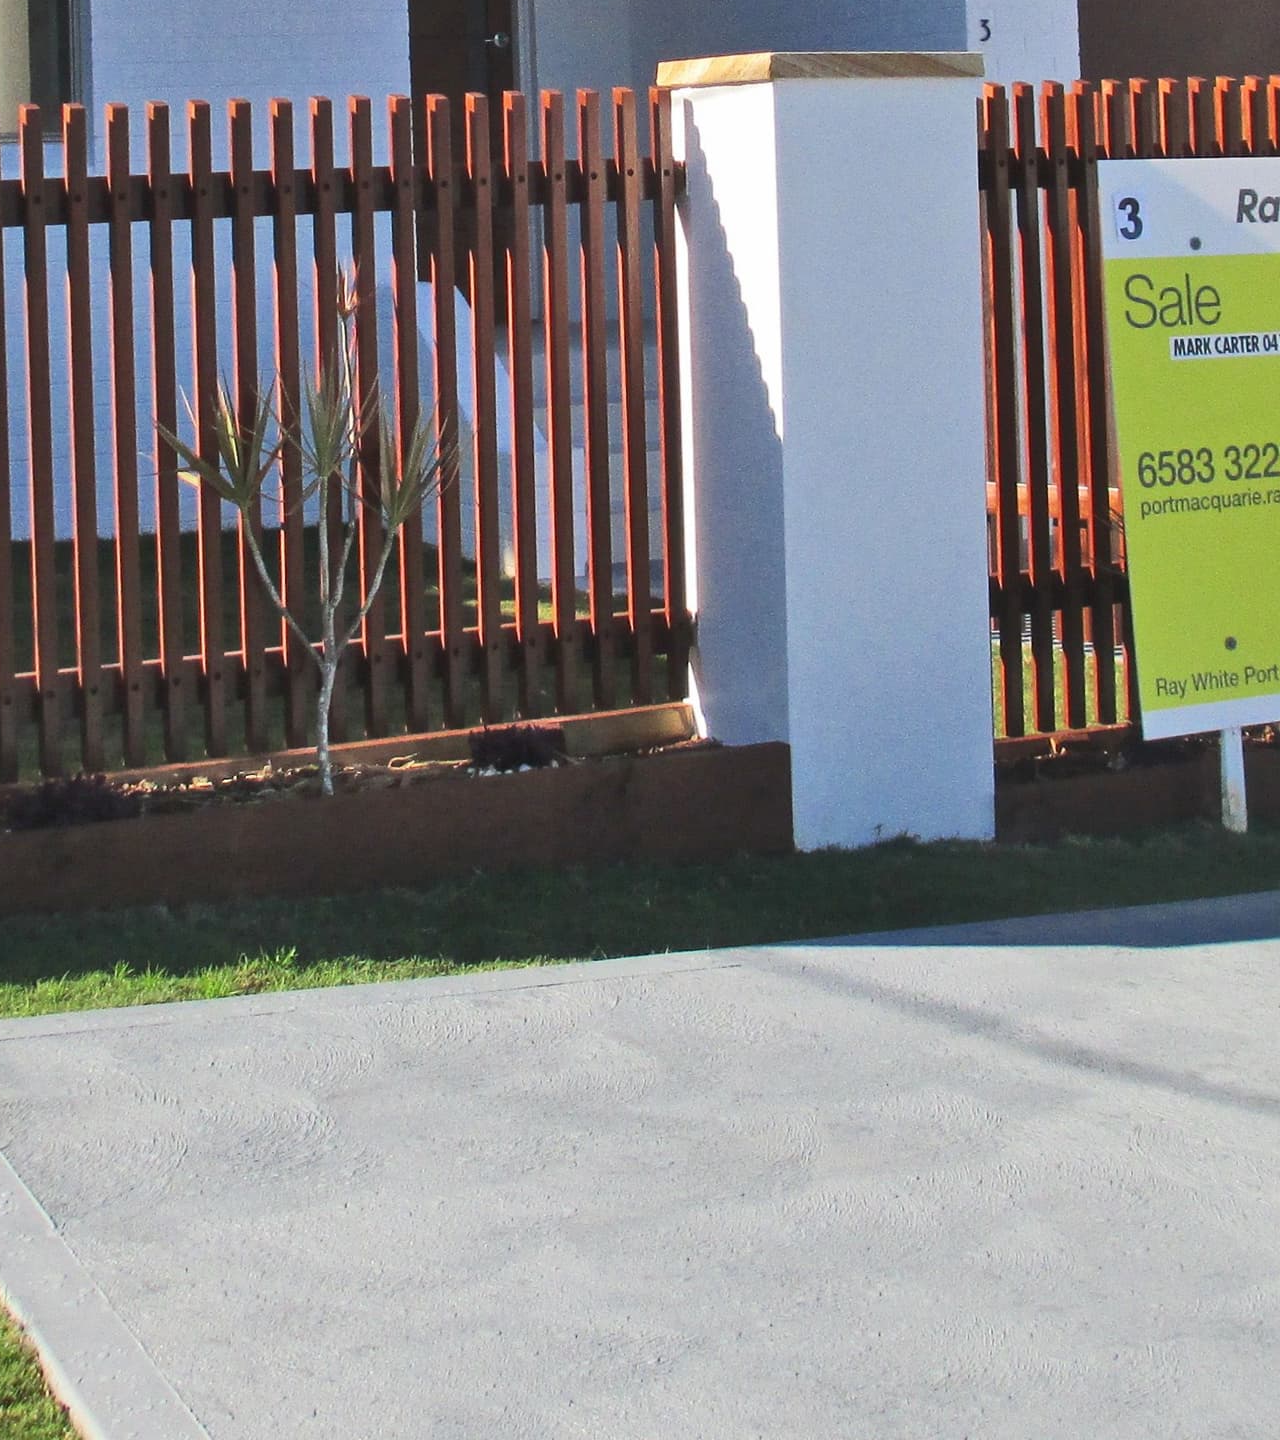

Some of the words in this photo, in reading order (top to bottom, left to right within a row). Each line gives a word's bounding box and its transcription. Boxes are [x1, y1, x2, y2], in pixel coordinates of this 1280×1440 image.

[979, 19, 991, 41] 3
[1118, 197, 1143, 240] 3
[1124, 273, 1221, 329] Sale
[1173, 336, 1212, 356] MARK
[1214, 334, 1260, 354] CARTER
[1137, 447, 1215, 488] 6583
[1156, 676, 1188, 699] Ray
[1192, 670, 1239, 692] White
[1244, 664, 1279, 685] Port
